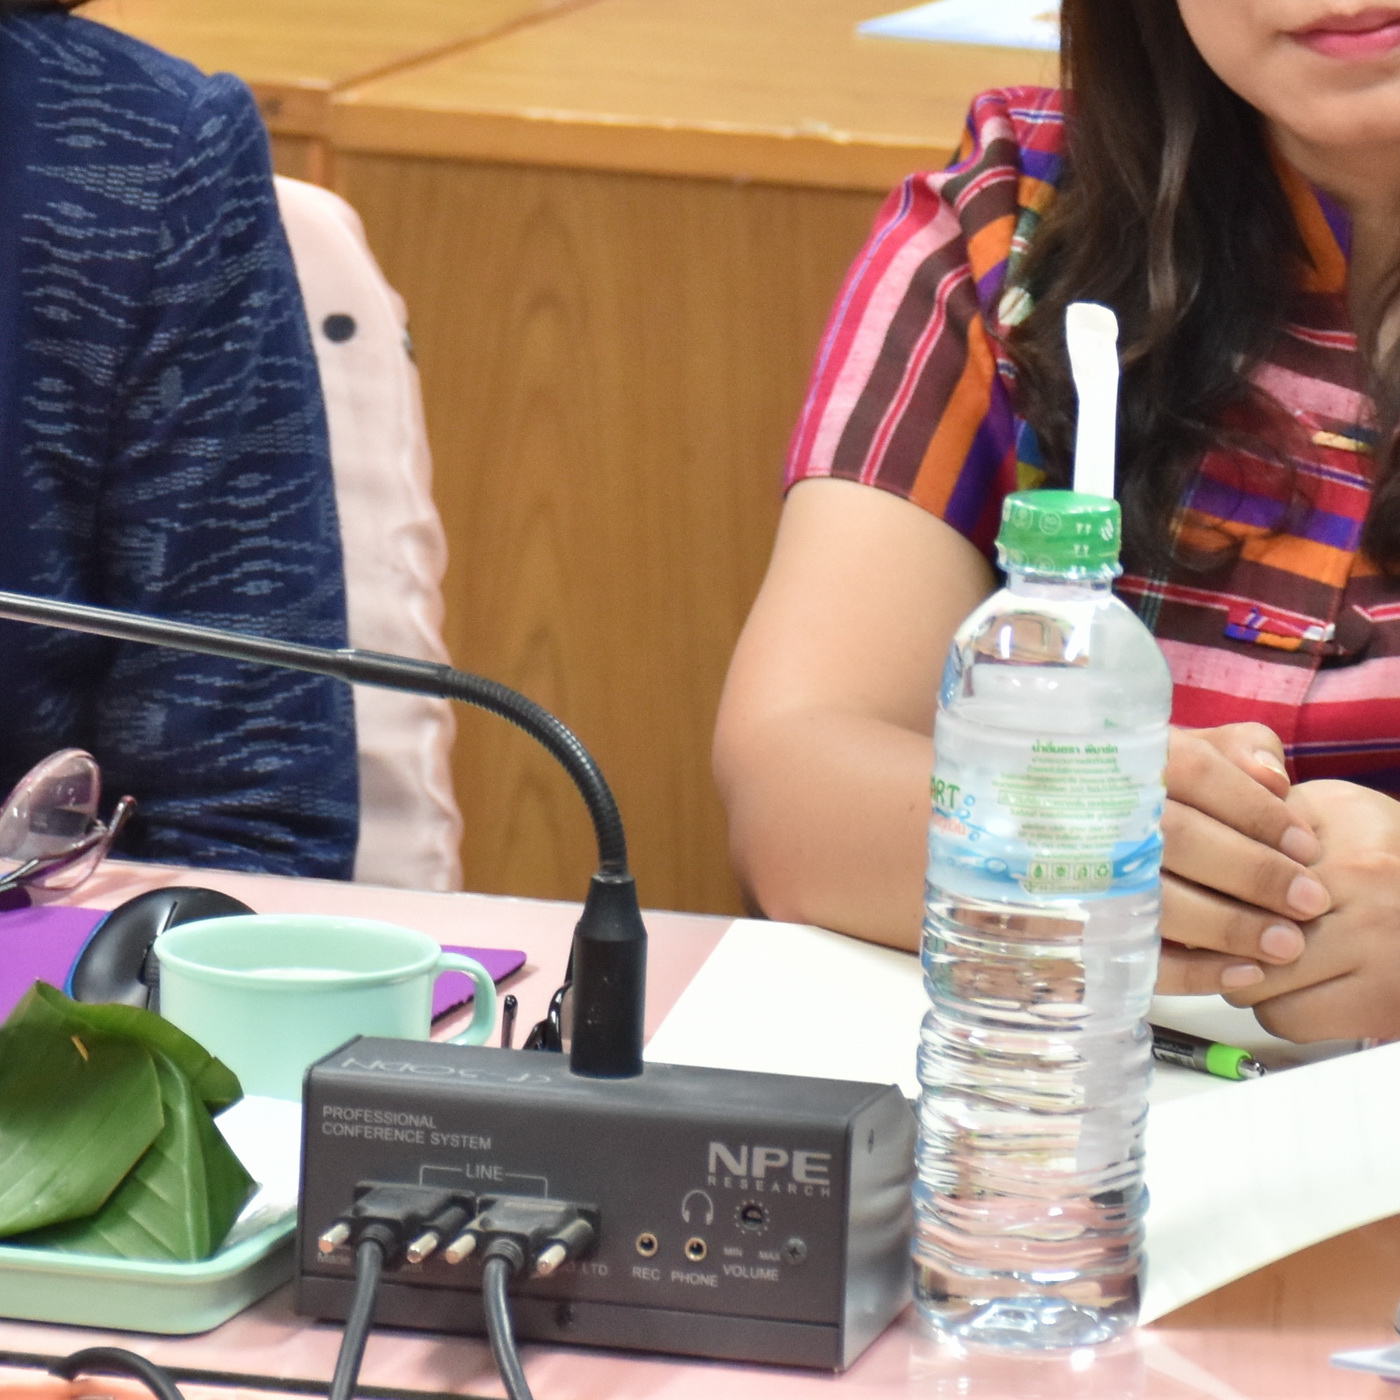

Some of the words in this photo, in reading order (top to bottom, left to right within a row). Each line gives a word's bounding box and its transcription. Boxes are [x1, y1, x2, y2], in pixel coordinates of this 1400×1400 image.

[322, 1104, 437, 1129] PROFESSIONAL
[321, 1121, 425, 1145] CONFERENCE
[430, 1131, 492, 1150] SYSTEM
[465, 1162, 504, 1181] LINE
[707, 1141, 832, 1186] NPE
[707, 1176, 831, 1198] RESEARCH
[723, 1246, 743, 1258] MIN
[632, 1266, 661, 1281] REC
[670, 1270, 719, 1288] PHONE
[723, 1264, 780, 1282] VOLUME
